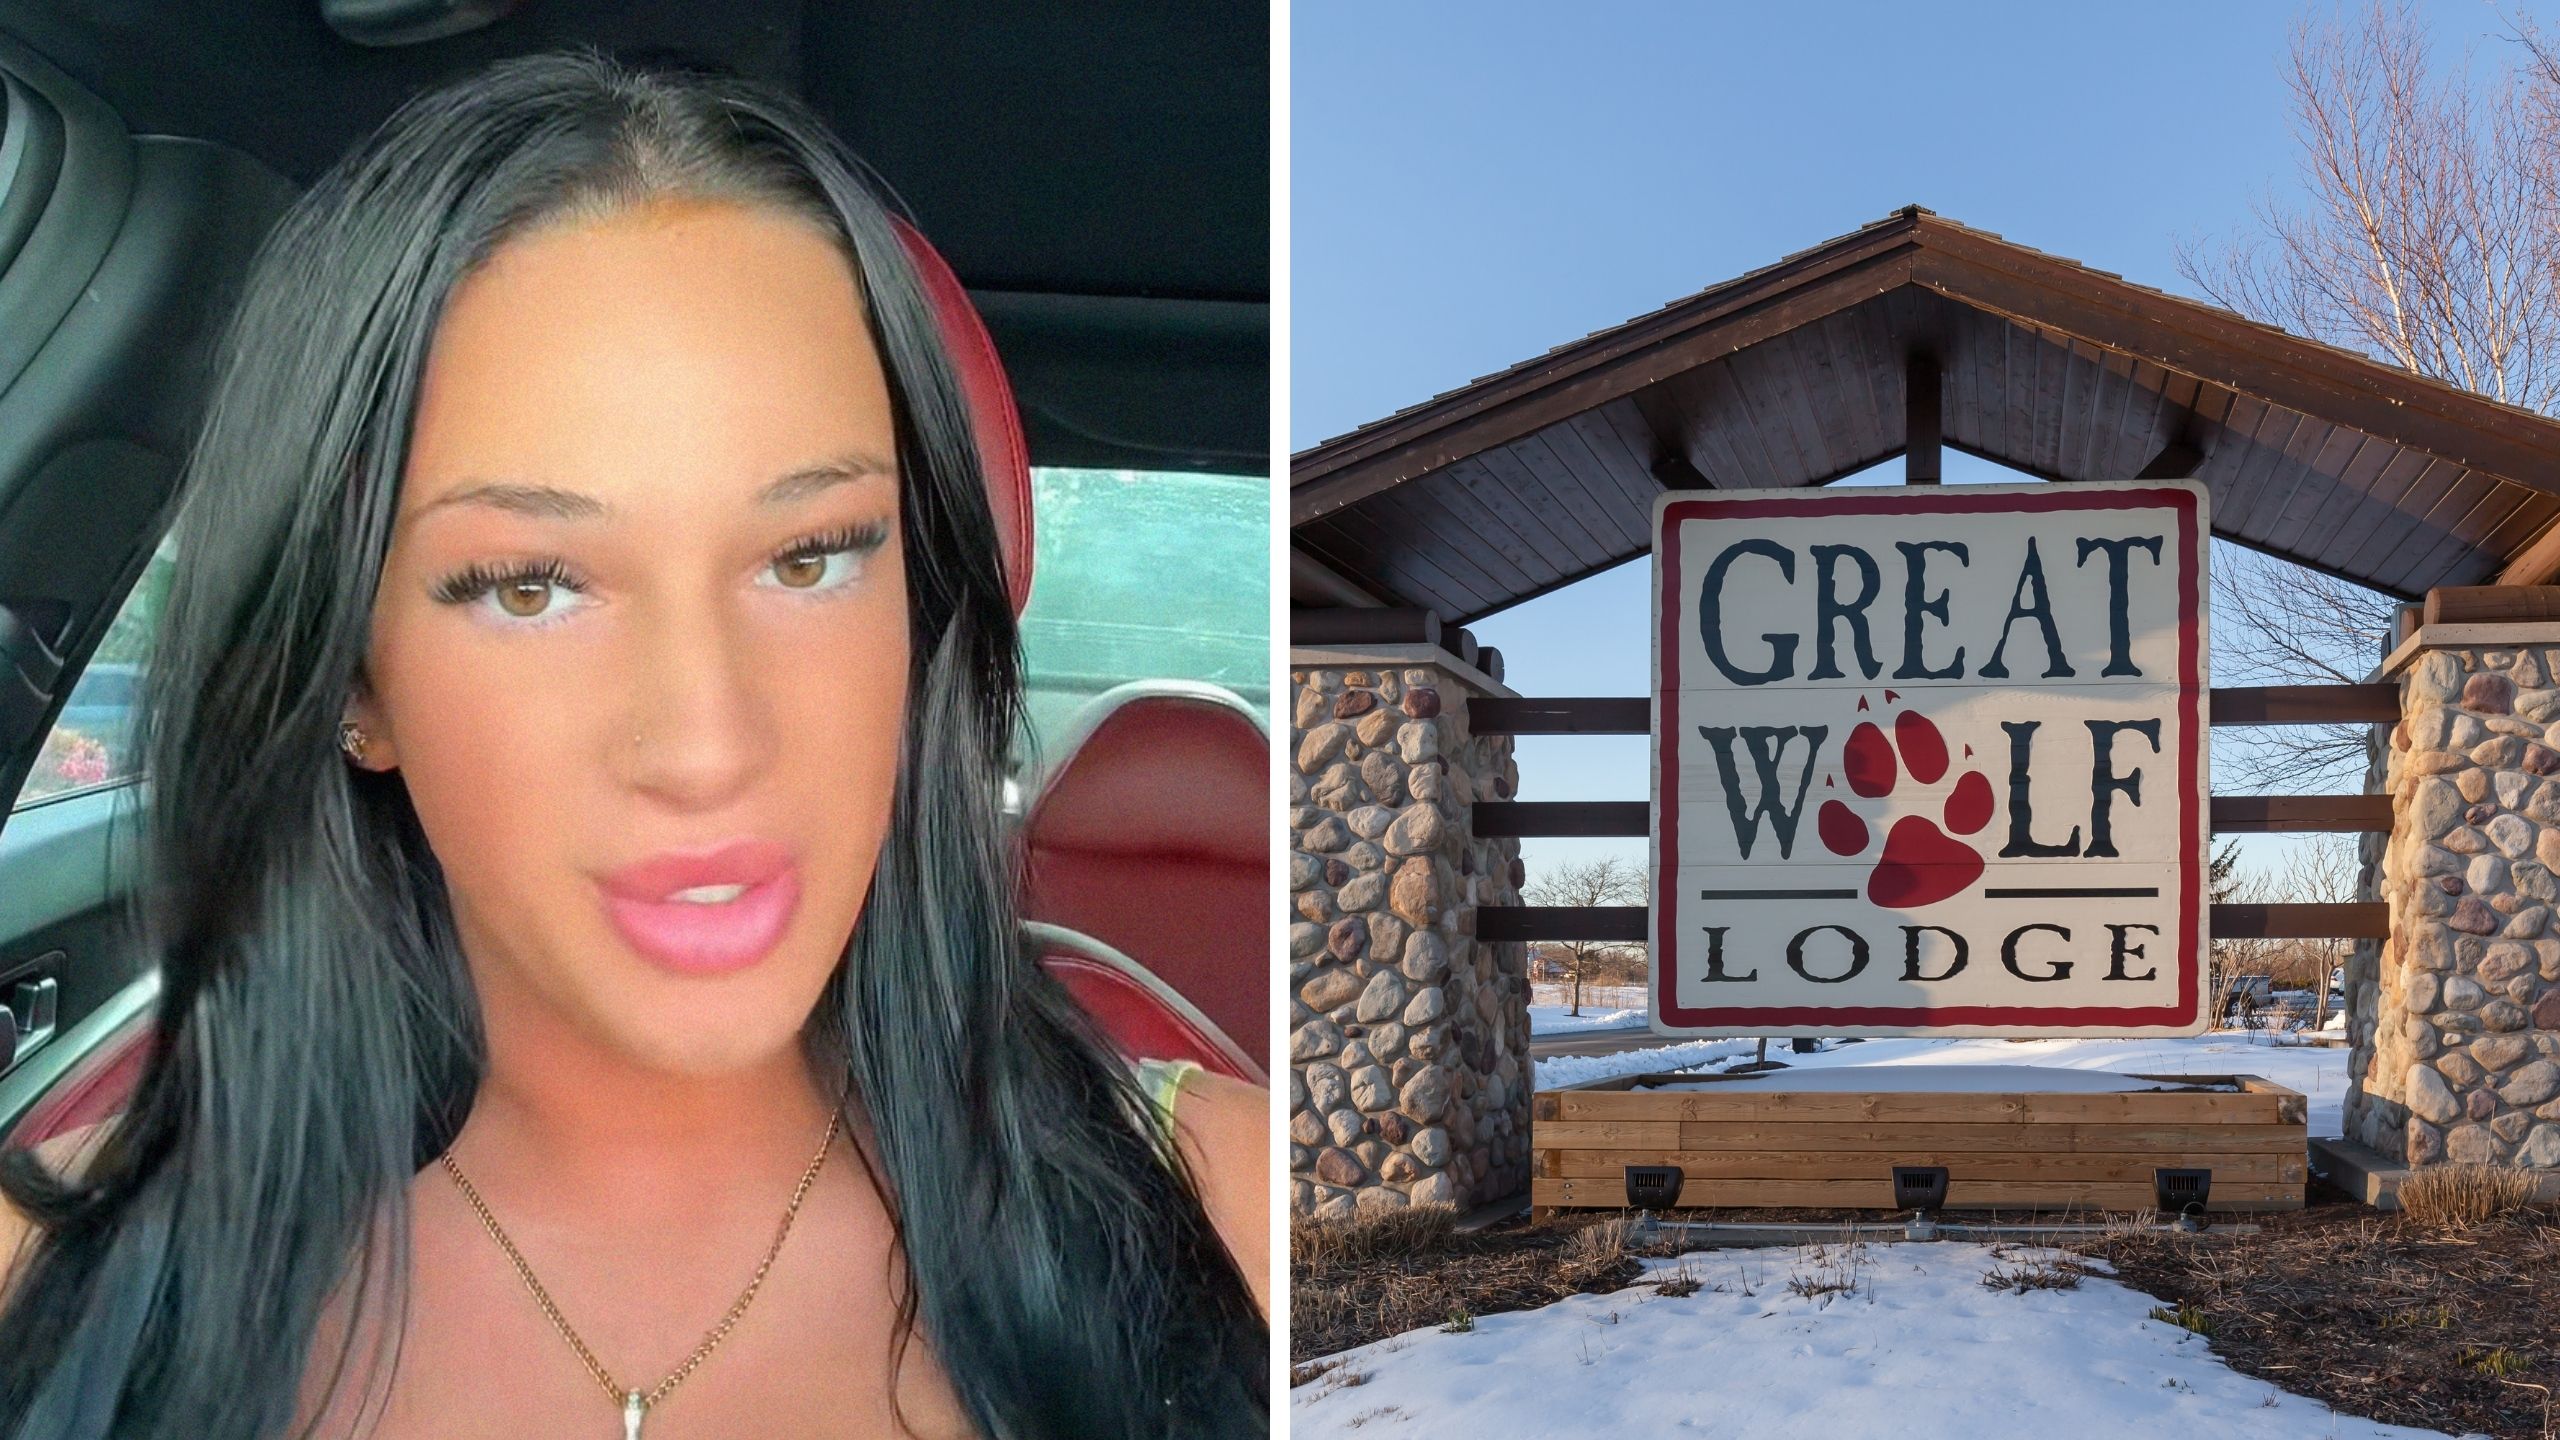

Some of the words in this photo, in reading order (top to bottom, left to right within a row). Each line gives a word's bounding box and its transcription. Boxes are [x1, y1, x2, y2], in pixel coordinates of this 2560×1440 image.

[1699, 536, 2163, 686] GREAT
[1698, 715, 2162, 861] WLF
[1700, 923, 2160, 983] LODGE
